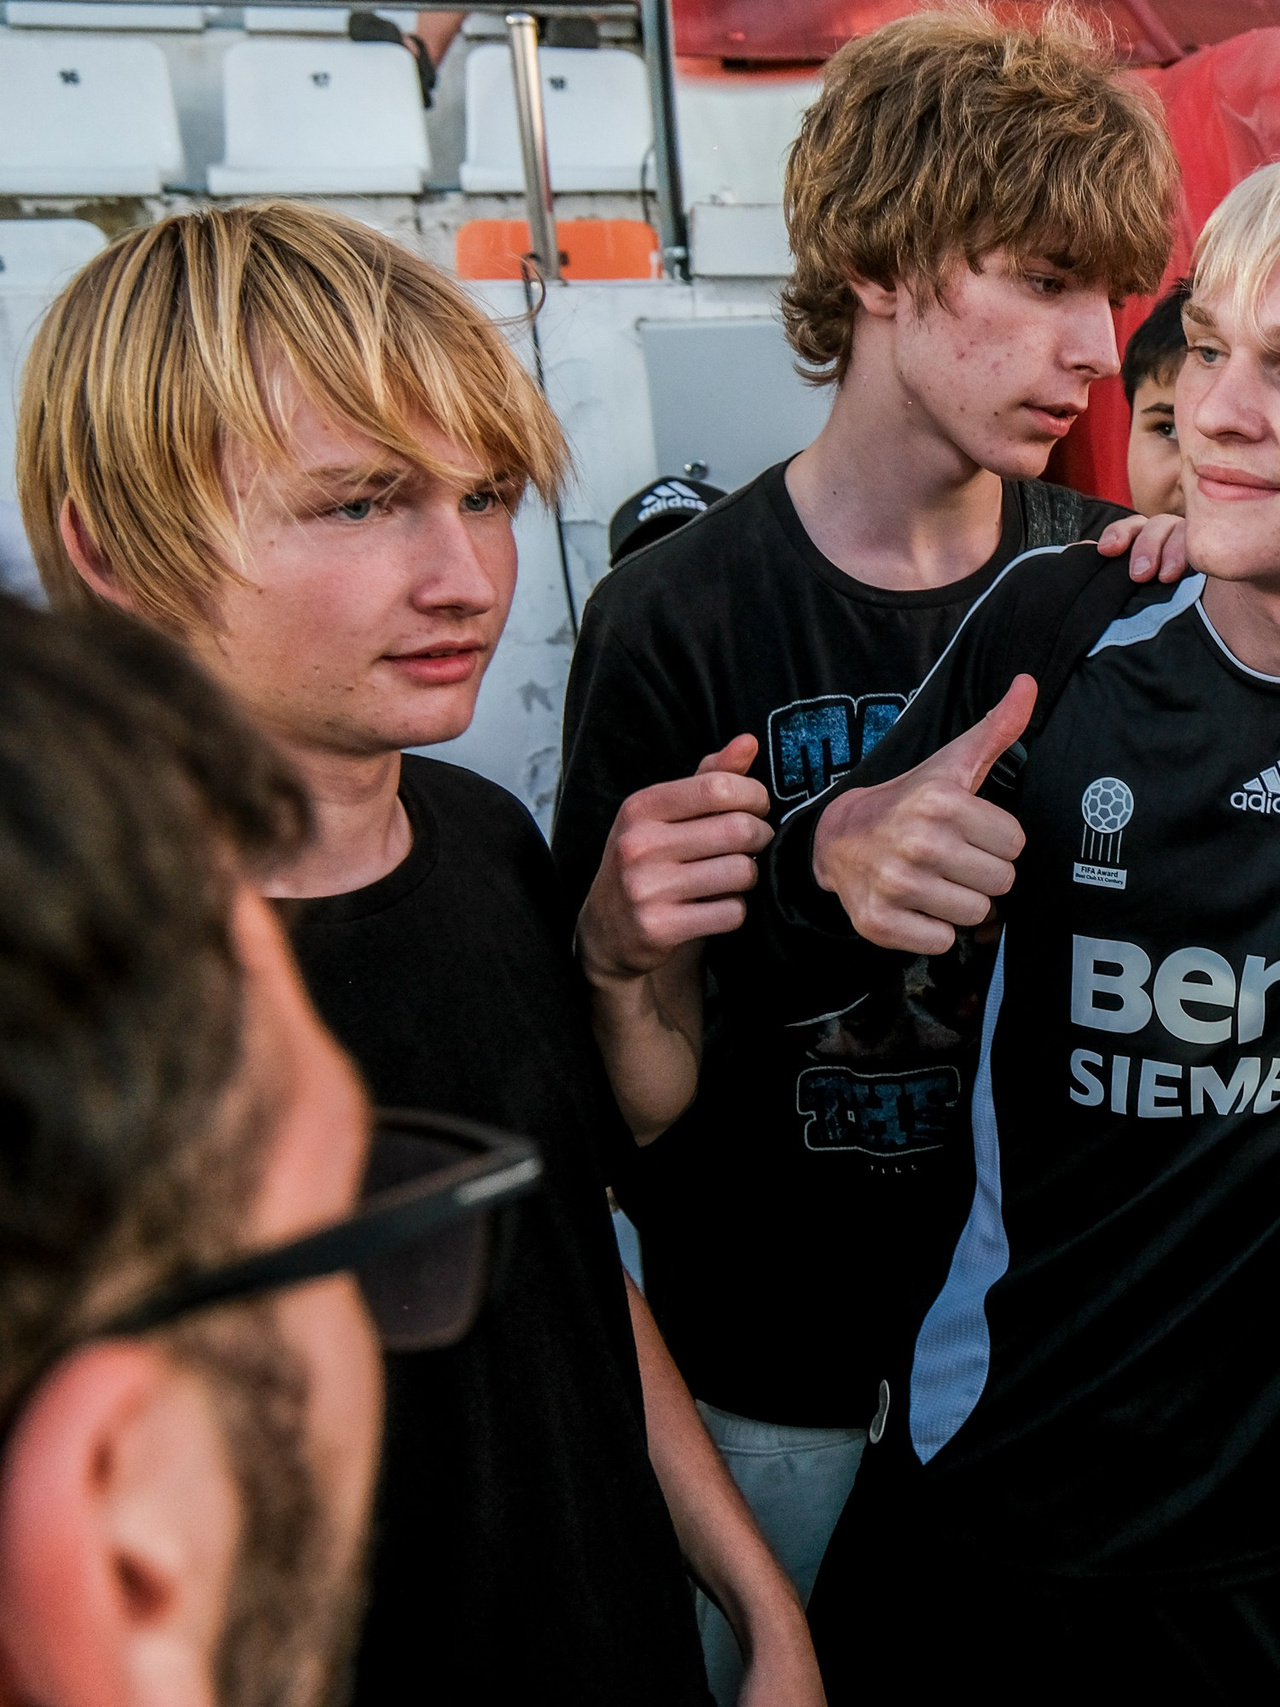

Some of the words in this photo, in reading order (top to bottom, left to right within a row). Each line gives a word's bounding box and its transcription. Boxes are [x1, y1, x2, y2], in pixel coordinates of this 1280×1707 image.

[637, 495, 708, 522] adidas
[1081, 866, 1095, 875] FIFA
[1097, 869, 1119, 878] Award
